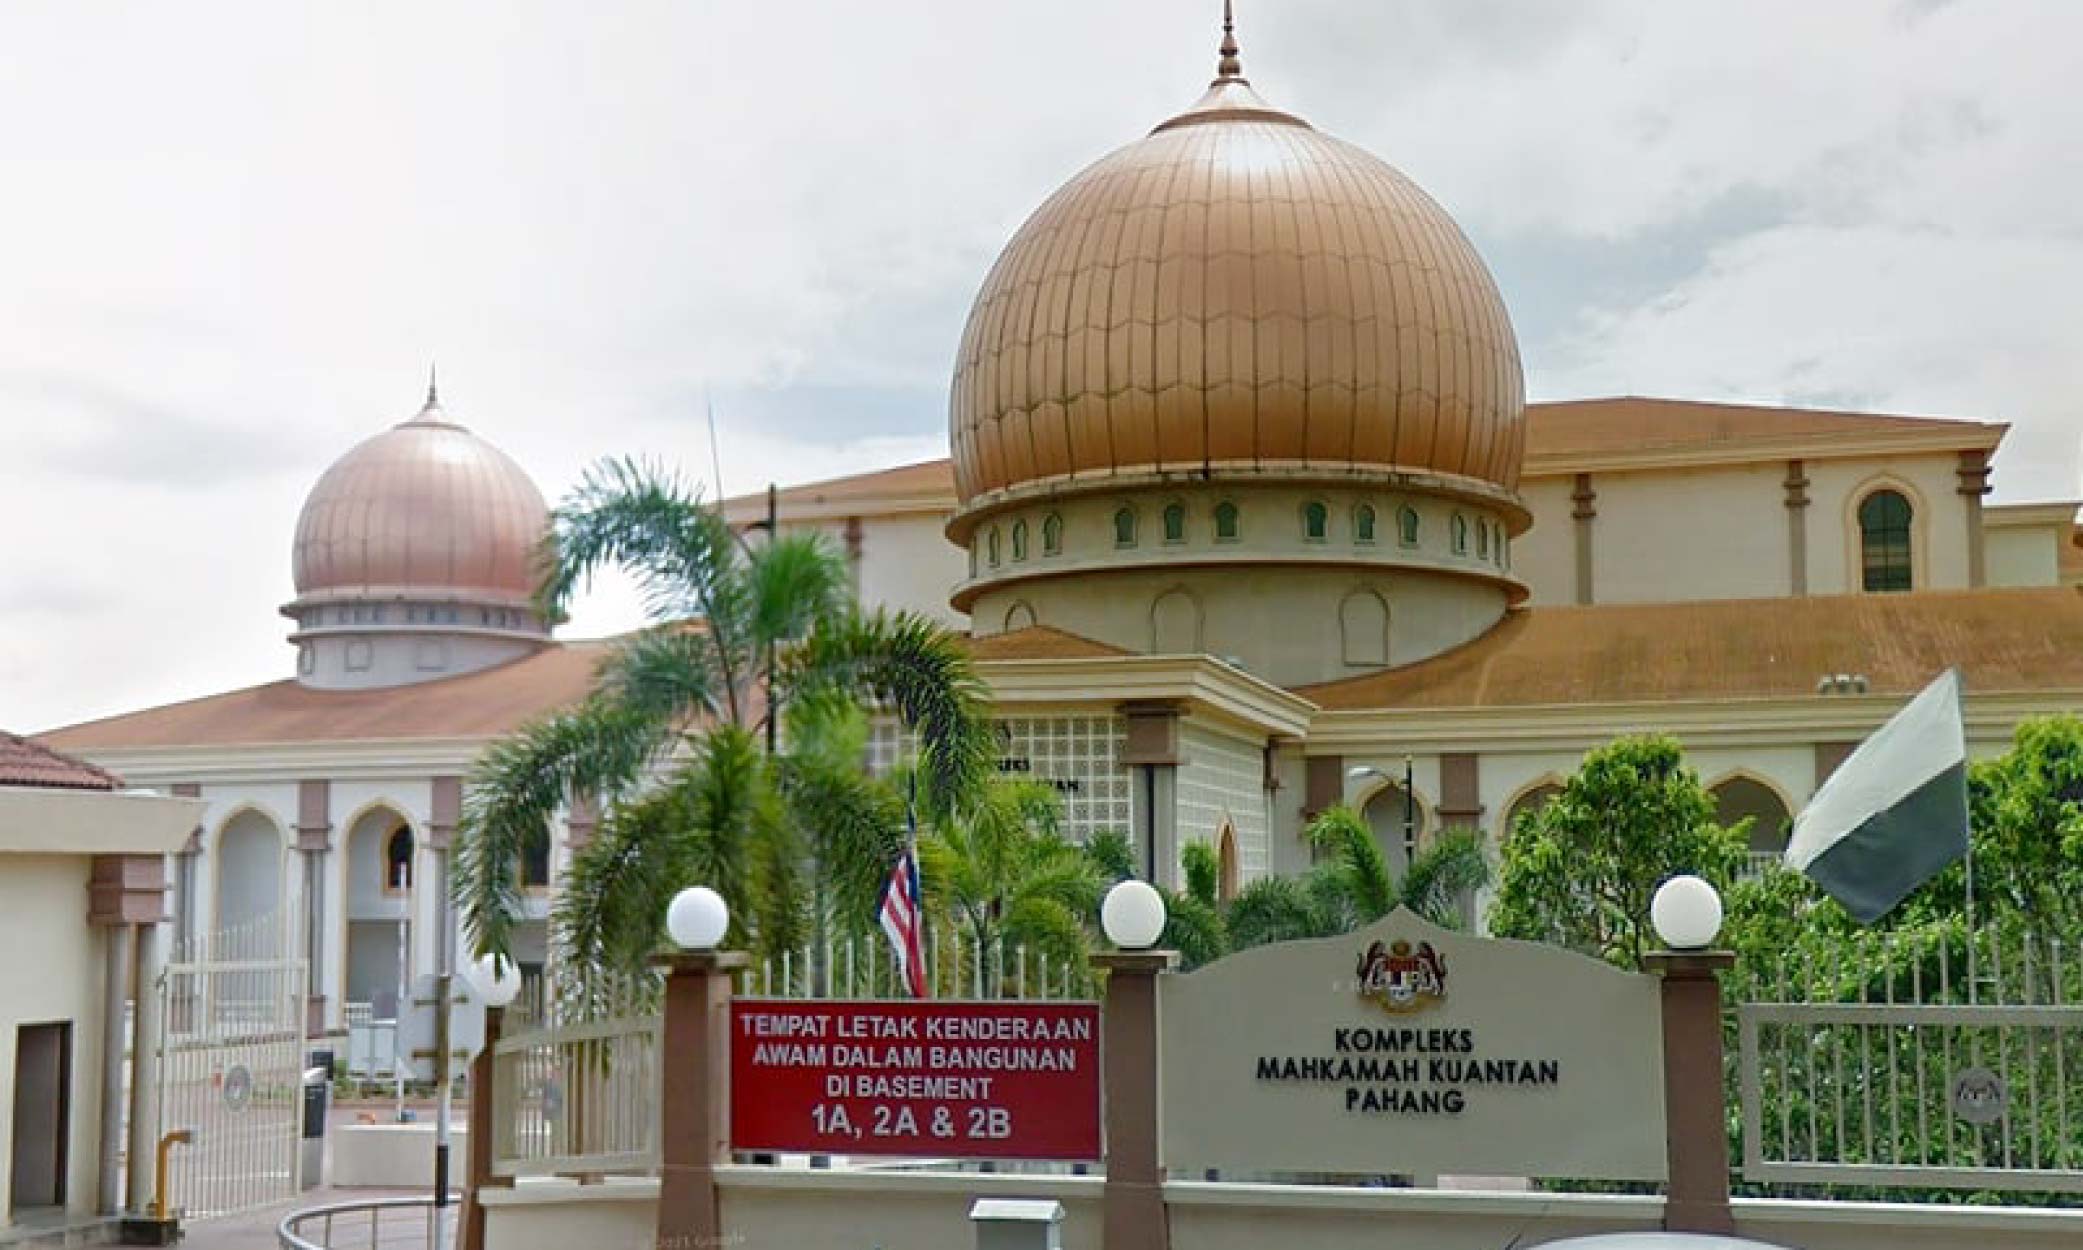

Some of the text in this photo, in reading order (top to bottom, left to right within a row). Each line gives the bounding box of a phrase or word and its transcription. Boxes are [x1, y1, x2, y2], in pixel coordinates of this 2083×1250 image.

[739, 1013, 1090, 1040] TEMPAT LETAK KENDERAAN
[1335, 1028, 1473, 1053] KOMPLEKS
[752, 1043, 1076, 1071] AWAM DALAM BANGUNAN
[1256, 1056, 1559, 1084] MAHKAMAH KUANTAN
[827, 1075, 992, 1100] DI BASEMENT
[1345, 1088, 1465, 1113] PAHANG
[811, 1104, 1012, 1140] 1A, 2A & 2B
